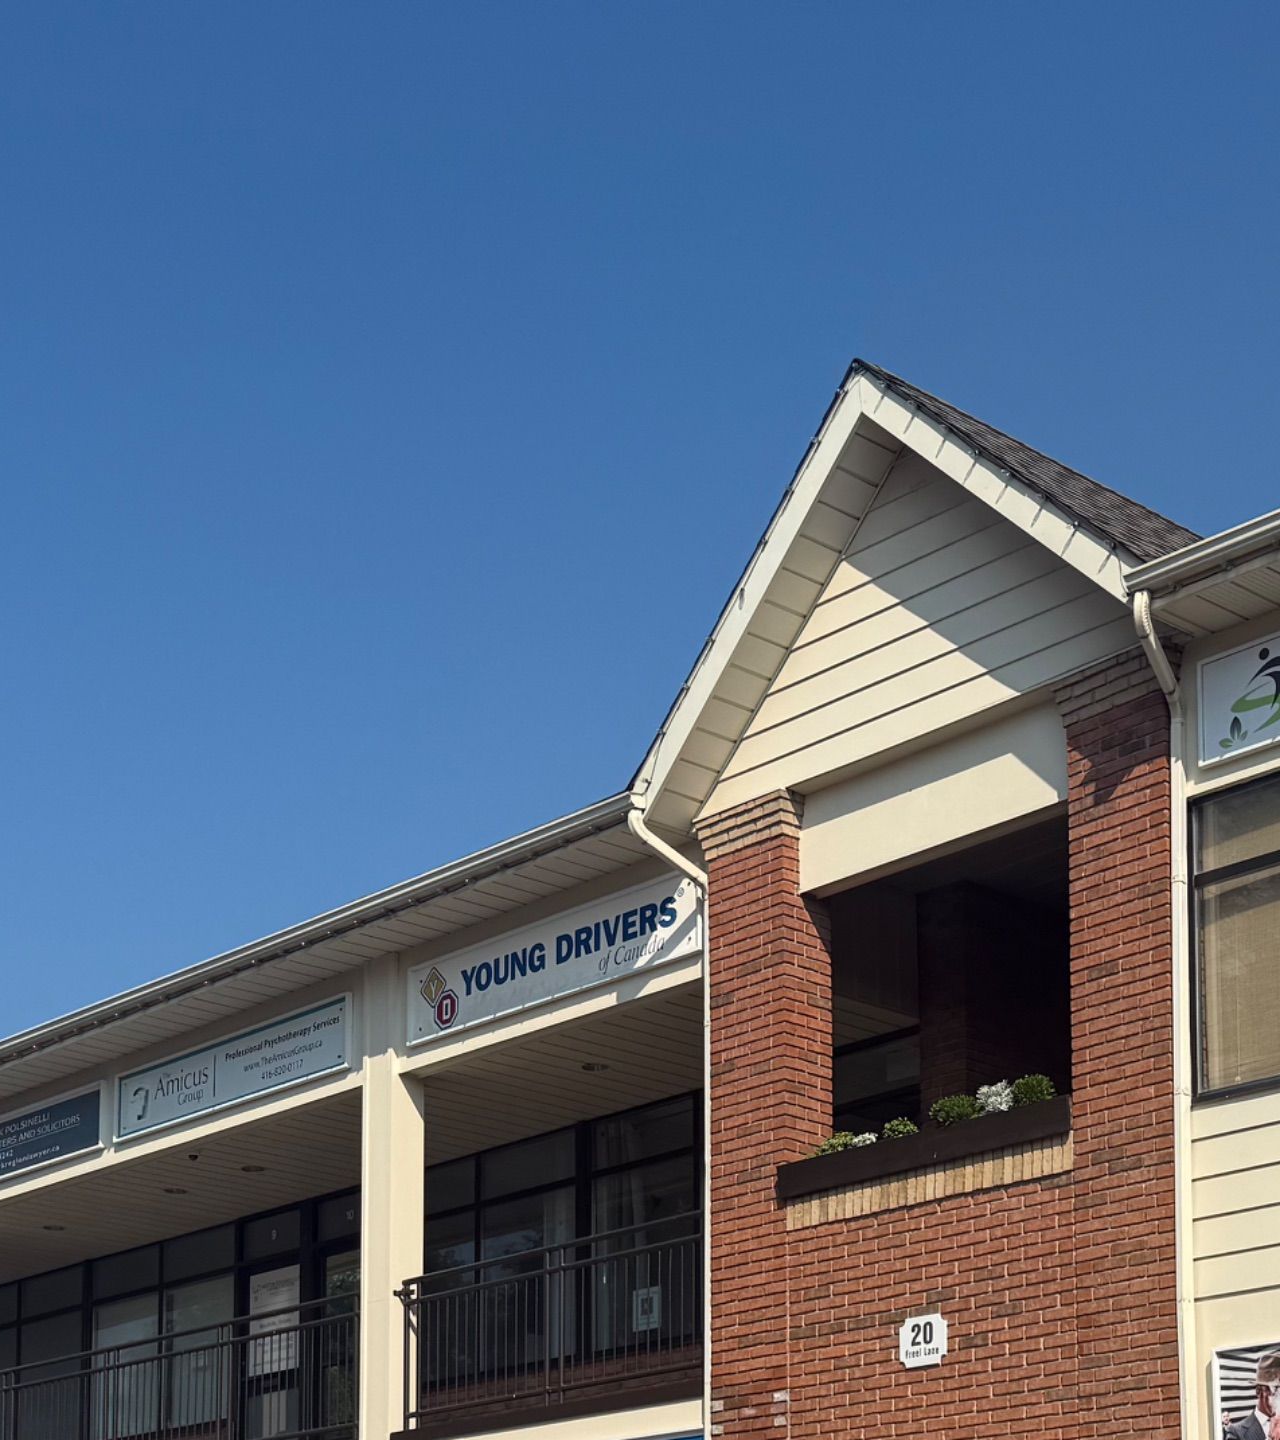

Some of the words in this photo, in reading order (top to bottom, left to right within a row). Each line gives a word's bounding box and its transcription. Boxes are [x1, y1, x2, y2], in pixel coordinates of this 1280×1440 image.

[461, 943, 546, 997] YOUNG
[556, 896, 677, 965] DRIVERS
[598, 951, 612, 976] of
[614, 934, 665, 967] Canada
[225, 1041, 263, 1063] Professional
[264, 1026, 311, 1049] Psychotherapy
[313, 1016, 340, 1032] Services
[154, 1066, 209, 1100] Amicus
[177, 1088, 204, 1106] Group
[19, 1129, 36, 1142] AND
[37, 1113, 81, 1135] SOLICITORS
[911, 1320, 933, 1347] 20
